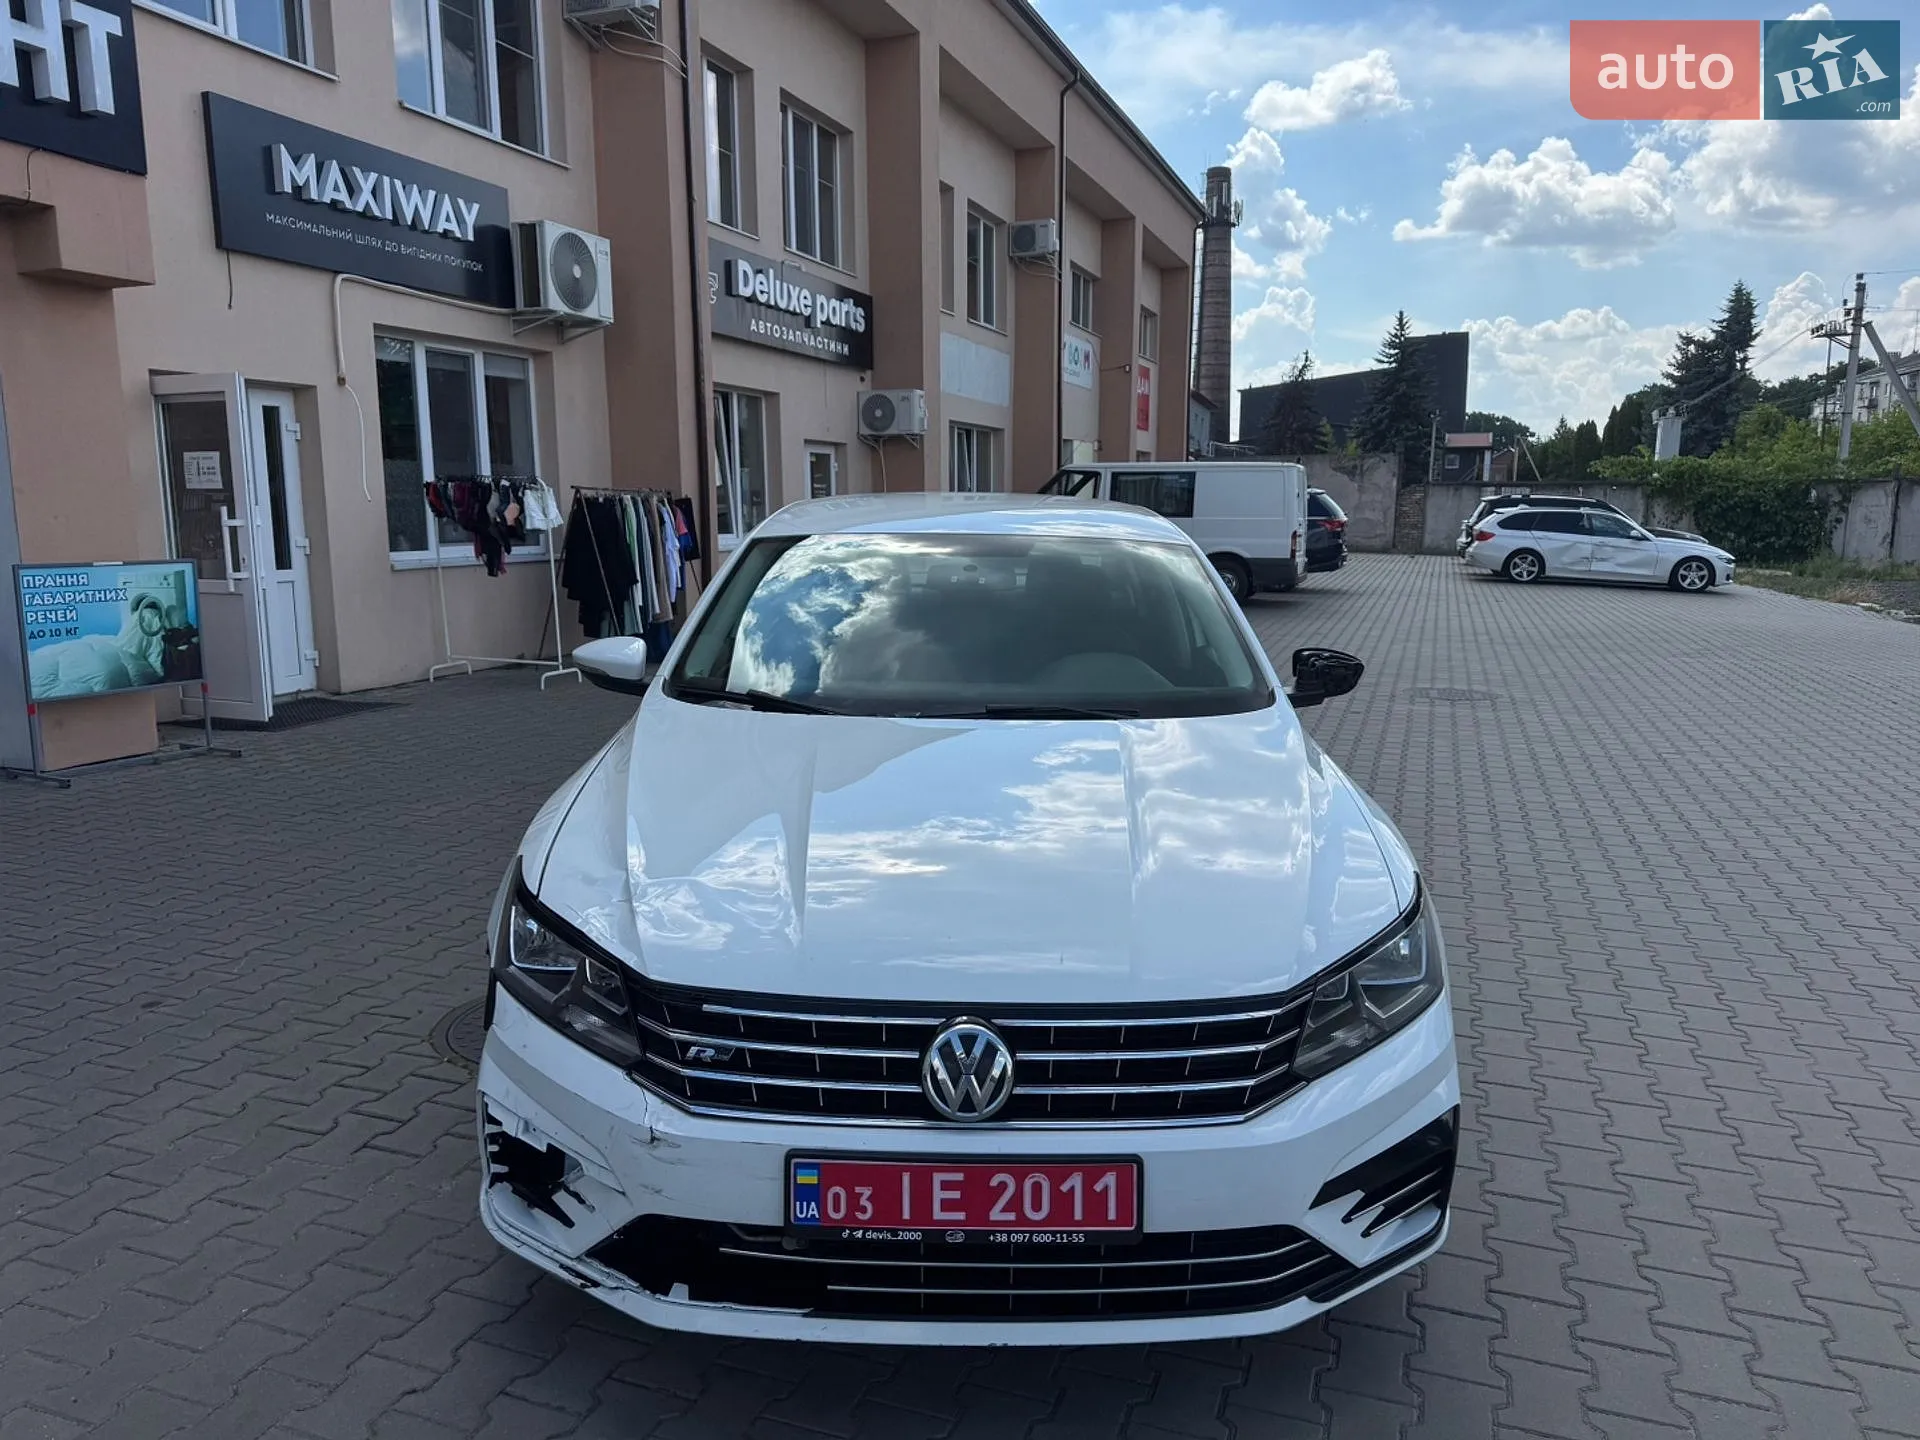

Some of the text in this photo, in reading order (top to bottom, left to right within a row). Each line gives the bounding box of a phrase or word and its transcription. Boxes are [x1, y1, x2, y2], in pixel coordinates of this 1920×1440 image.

[273, 143, 480, 241] MAXIWAY
[265, 211, 353, 242] МАКСИМАЛЬНИЙ
[354, 233, 383, 251] ШЛЯХ
[384, 240, 399, 253] ДО
[443, 254, 484, 272] ПОКУПОК
[734, 259, 866, 332] Deluxe parts
[750, 318, 849, 356] АВТОЗАПЧАСТИНИ
[22, 573, 89, 588] ПРАННЯ
[24, 588, 128, 606] ГАБАРИТНИХ
[26, 606, 79, 625] РЕЧЕЙ
[28, 626, 80, 641] ДО 10 КГ
[826, 1186, 873, 1220] 03
[989, 1172, 1117, 1221] 2011
[796, 1201, 819, 1218] UA
[865, 1230, 922, 1241] devis_2000
[988, 1233, 1085, 1243] +38 097 600-11-55
